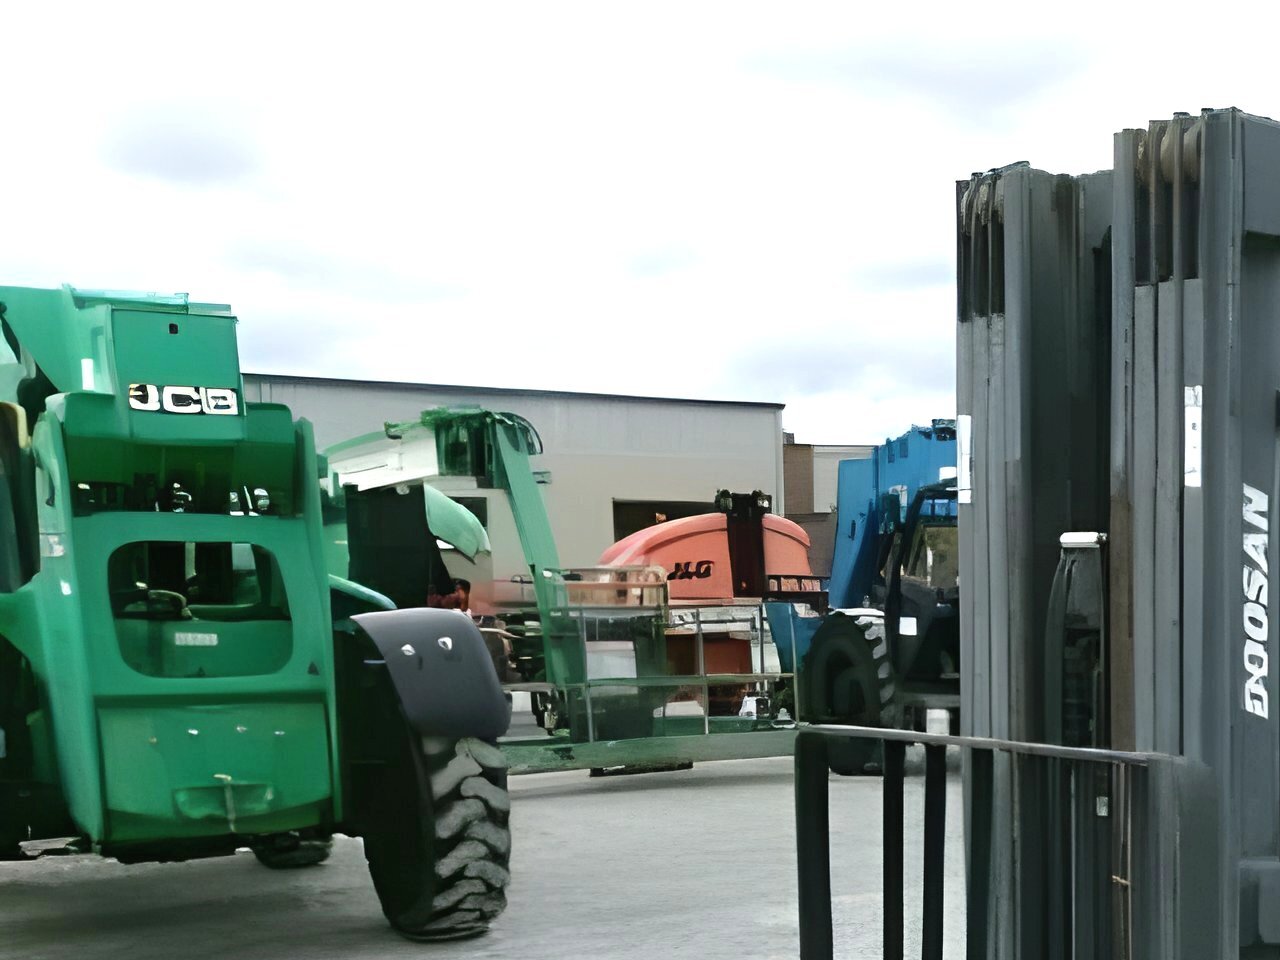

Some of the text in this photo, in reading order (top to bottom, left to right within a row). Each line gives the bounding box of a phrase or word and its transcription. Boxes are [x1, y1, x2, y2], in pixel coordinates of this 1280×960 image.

[129, 384, 238, 415] JCB
[667, 561, 714, 580] JLG
[1243, 483, 1269, 719] DOOSAN
